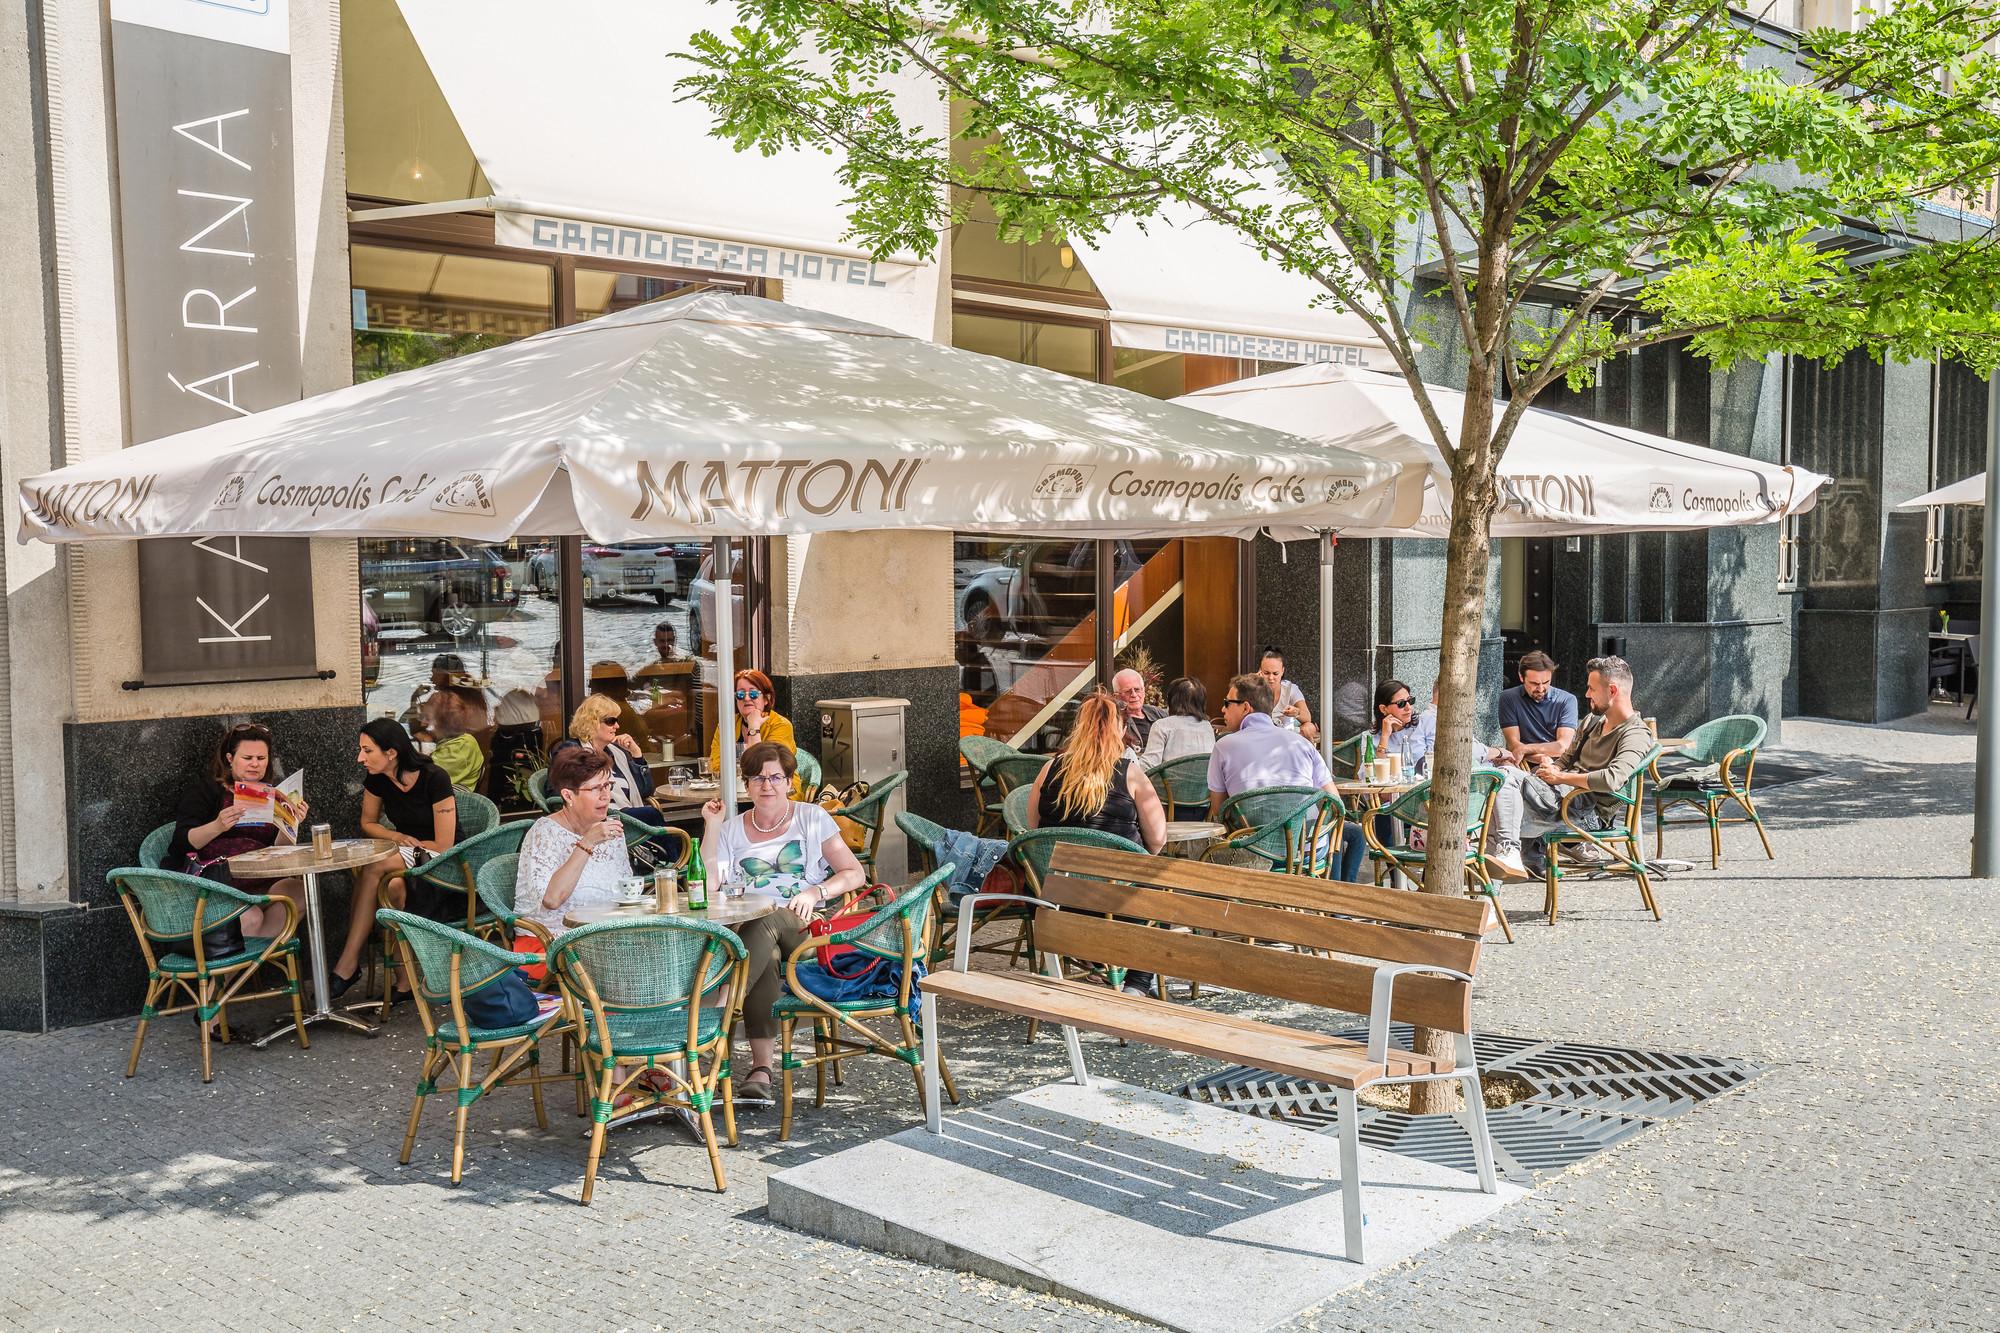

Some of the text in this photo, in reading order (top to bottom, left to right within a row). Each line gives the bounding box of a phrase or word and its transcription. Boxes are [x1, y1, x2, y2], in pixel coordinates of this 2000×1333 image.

[533, 218, 887, 288] GRANDEZZA HOTEL
[1165, 328, 1369, 367] GRANDEZZA HOTEL
[167, 107, 272, 644] KAÁRNA
[24, 473, 160, 529] MATTONI
[256, 472, 371, 517] Cosmopolis
[630, 458, 922, 525] MATTONI
[1108, 470, 1306, 508] Cosmopolis Café
[1682, 488, 1754, 517] Cosmopolis
